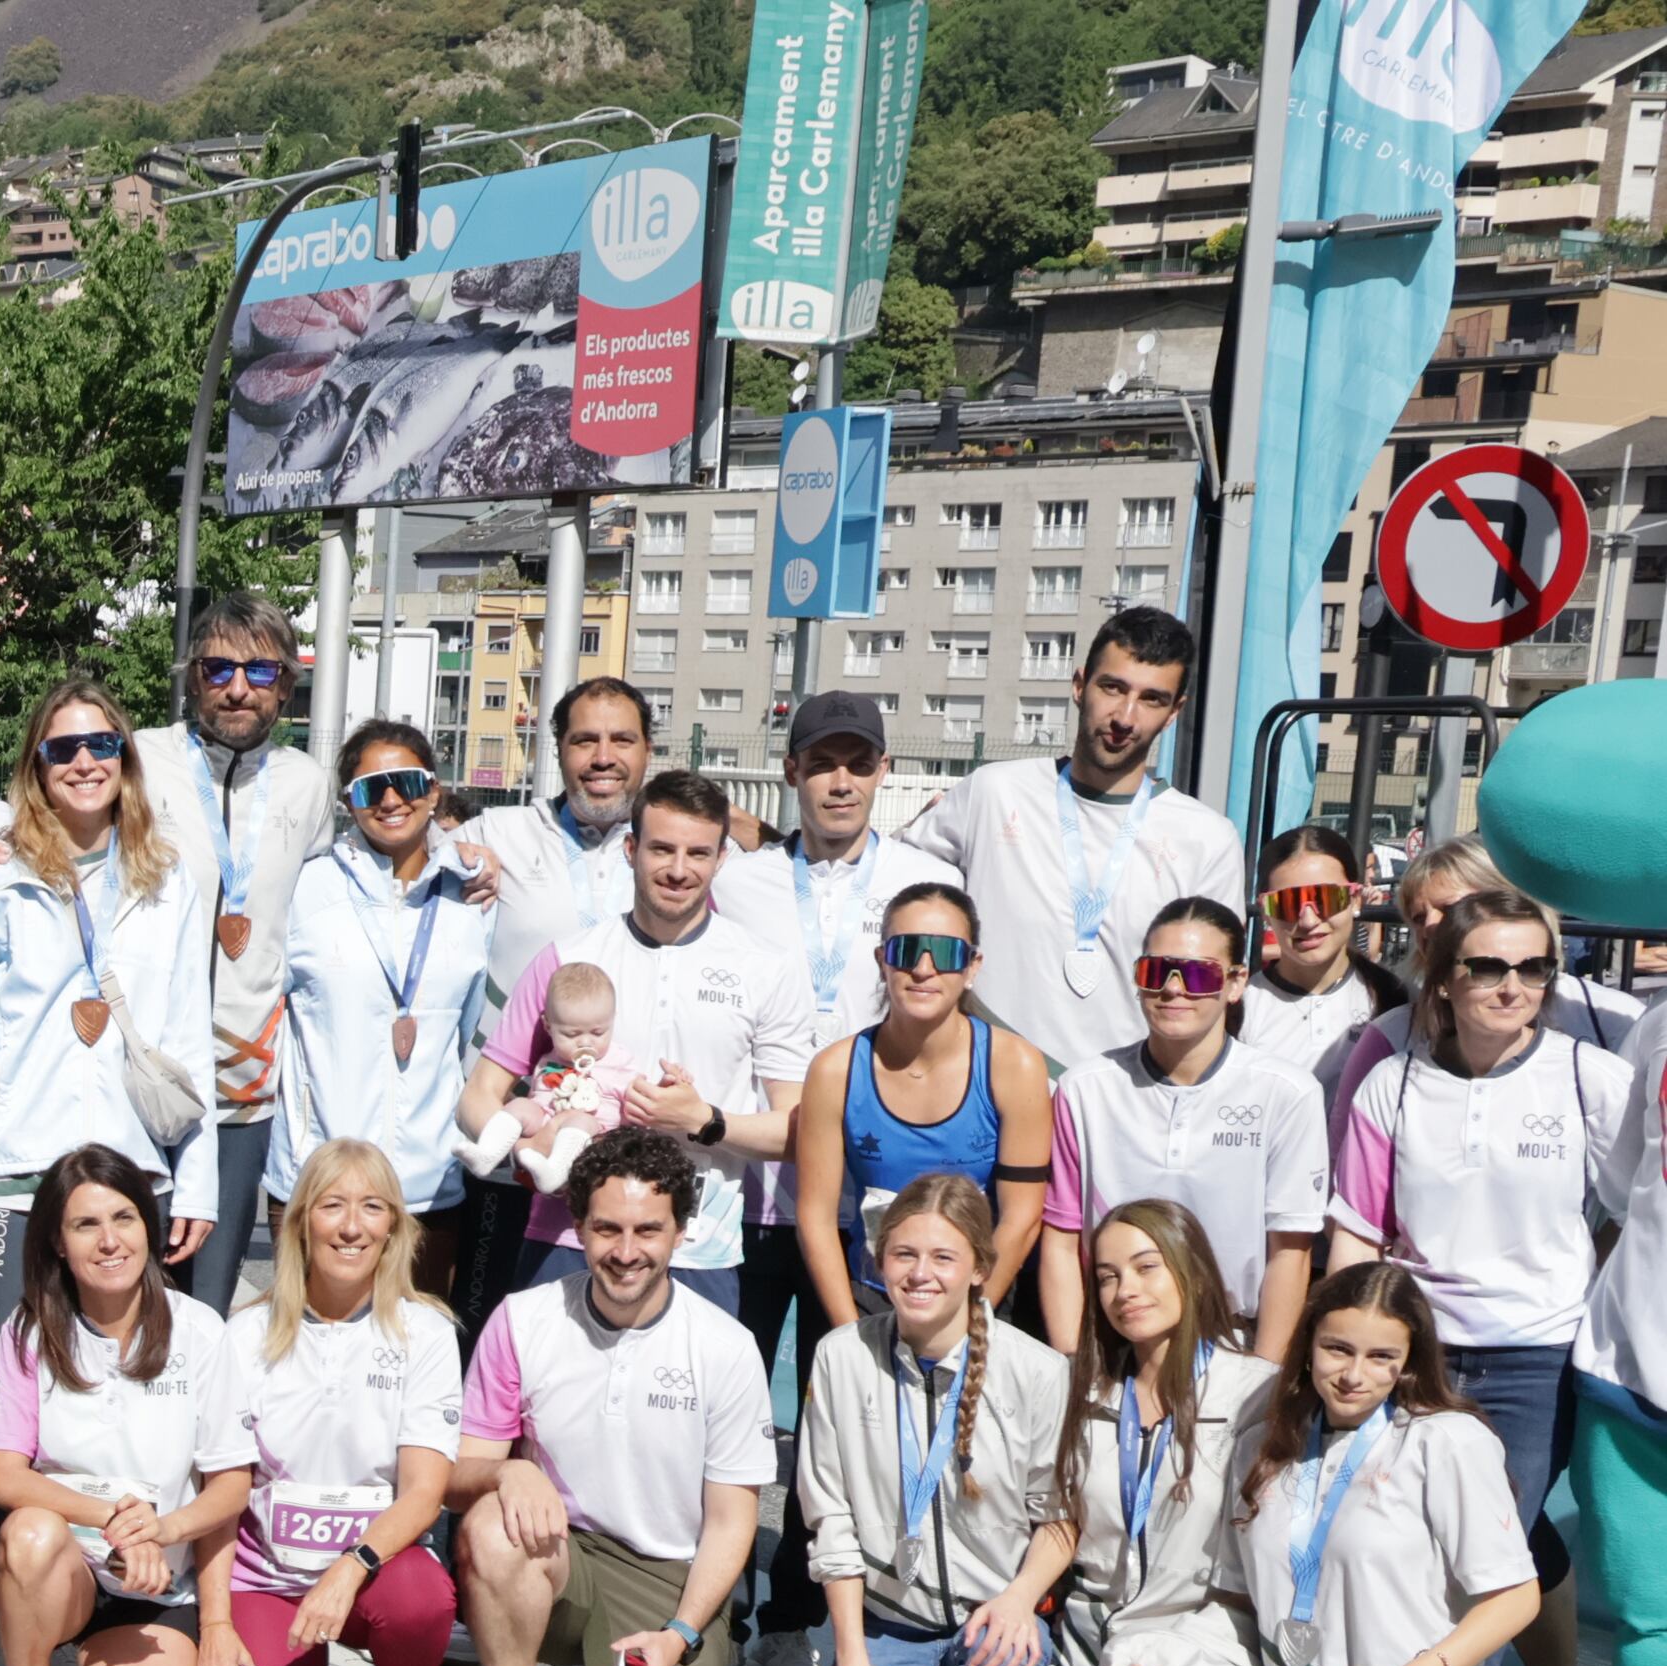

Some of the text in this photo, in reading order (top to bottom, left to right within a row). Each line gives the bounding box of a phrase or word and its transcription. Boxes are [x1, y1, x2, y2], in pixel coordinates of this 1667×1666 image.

[793, 1, 855, 256] illa Carlemany
[753, 35, 804, 255] Aparcament
[604, 168, 670, 247] illa
[744, 280, 814, 330] illa
[585, 328, 691, 360] Els productes
[583, 363, 673, 390] més frescos
[580, 399, 659, 424] d'Andorra
[259, 468, 274, 488] de
[784, 467, 834, 496] caprabo
[697, 989, 743, 1009] MOU-TE
[1212, 1131, 1262, 1148] MOU-TE
[144, 1380, 189, 1396] MOU-TE
[647, 1392, 698, 1412] MOU-TE
[291, 1512, 369, 1545] 2671
